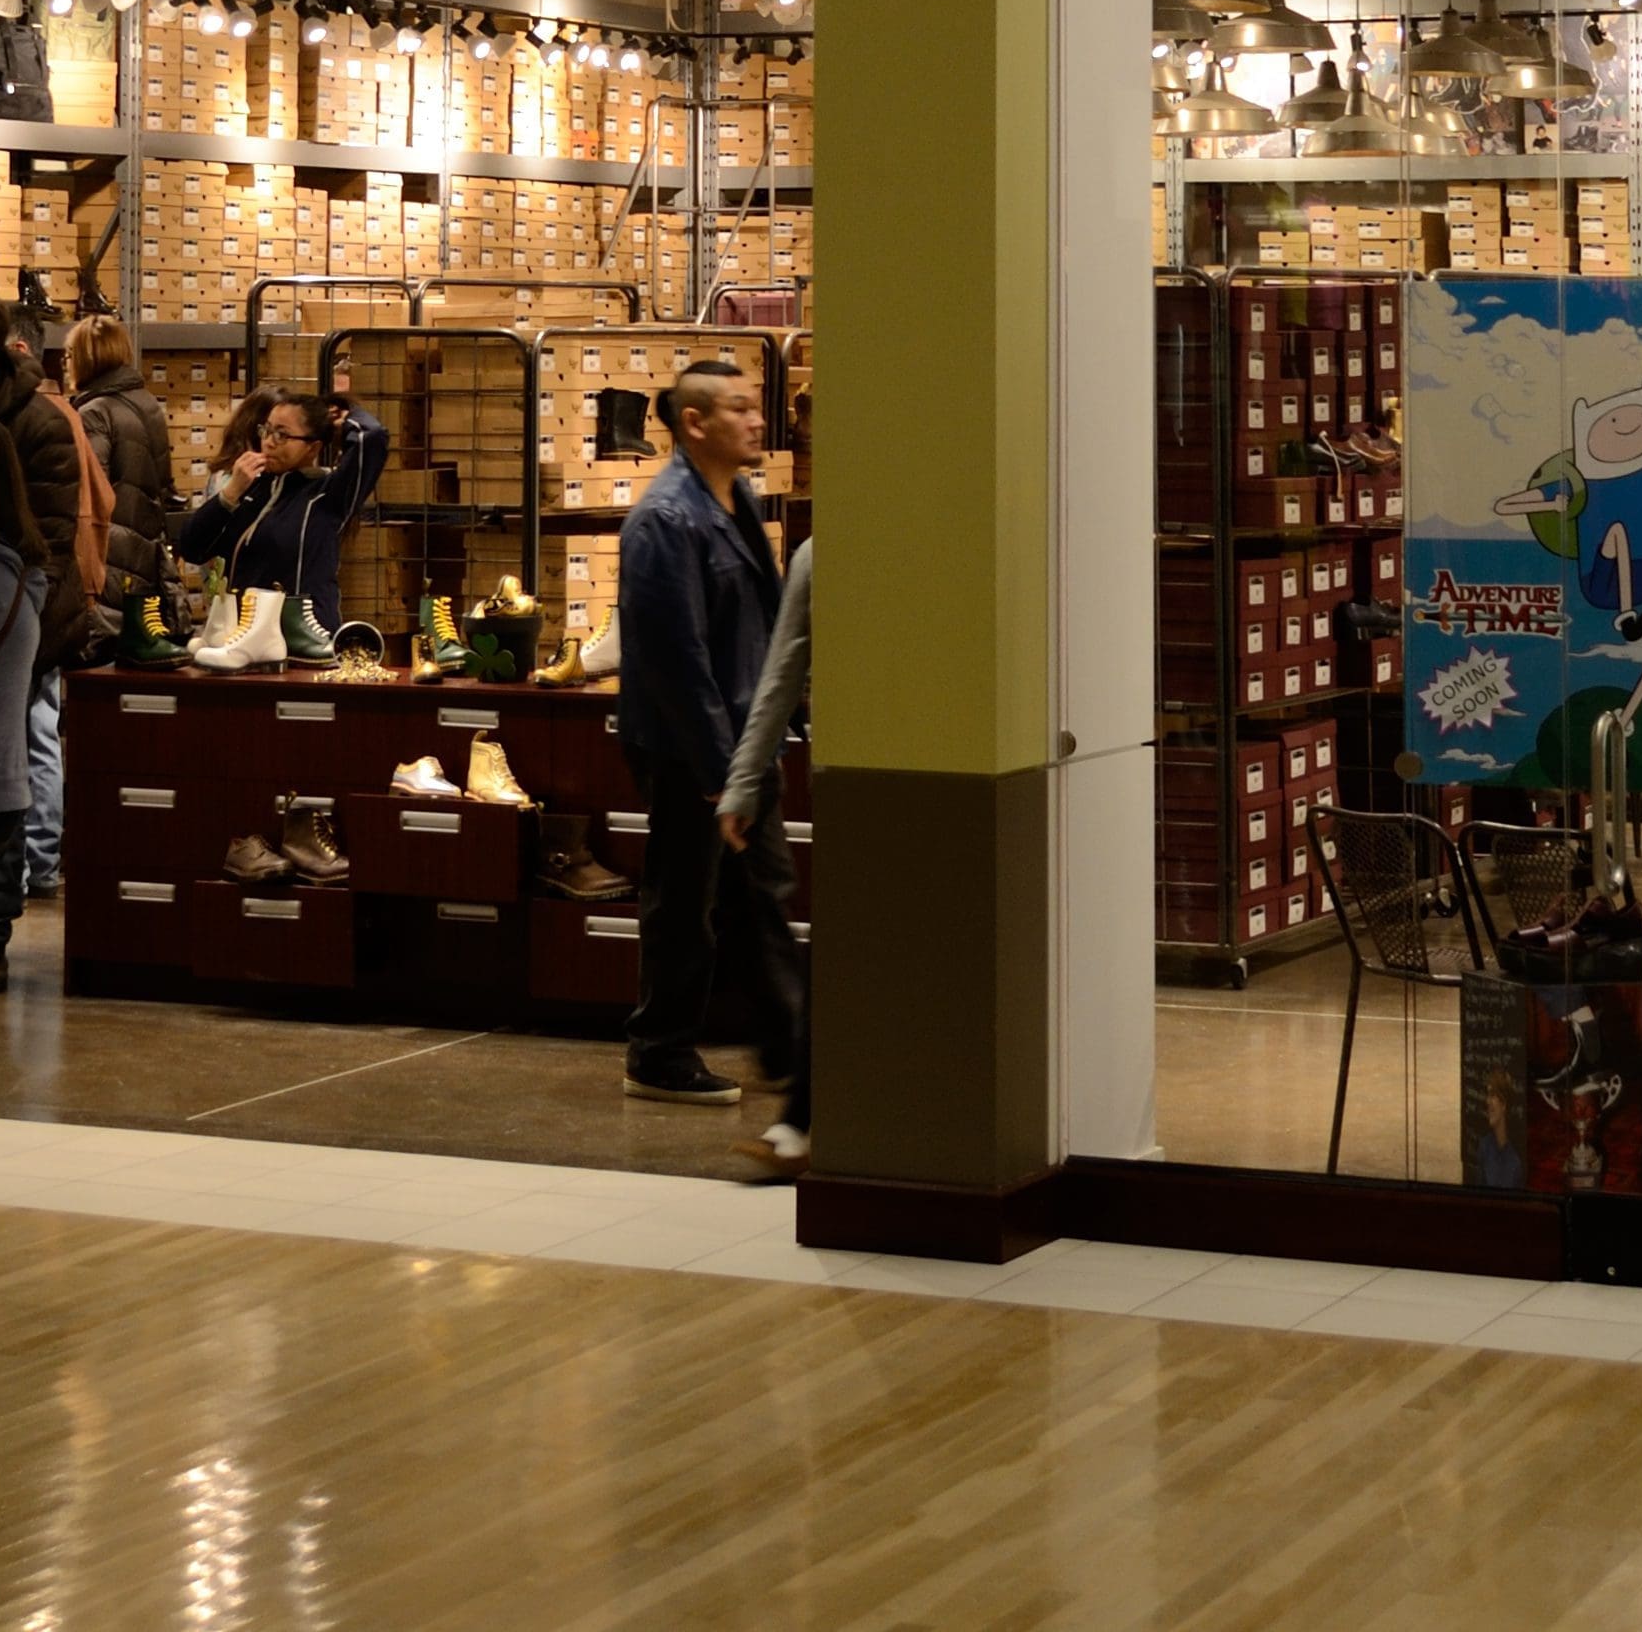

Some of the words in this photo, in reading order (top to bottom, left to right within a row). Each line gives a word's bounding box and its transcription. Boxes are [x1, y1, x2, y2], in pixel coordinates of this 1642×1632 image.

[1429, 571, 1561, 604] ADVENTURE
[1455, 602, 1561, 636] TIME
[1431, 657, 1498, 707] COMING
[1452, 682, 1501, 720] SOON
